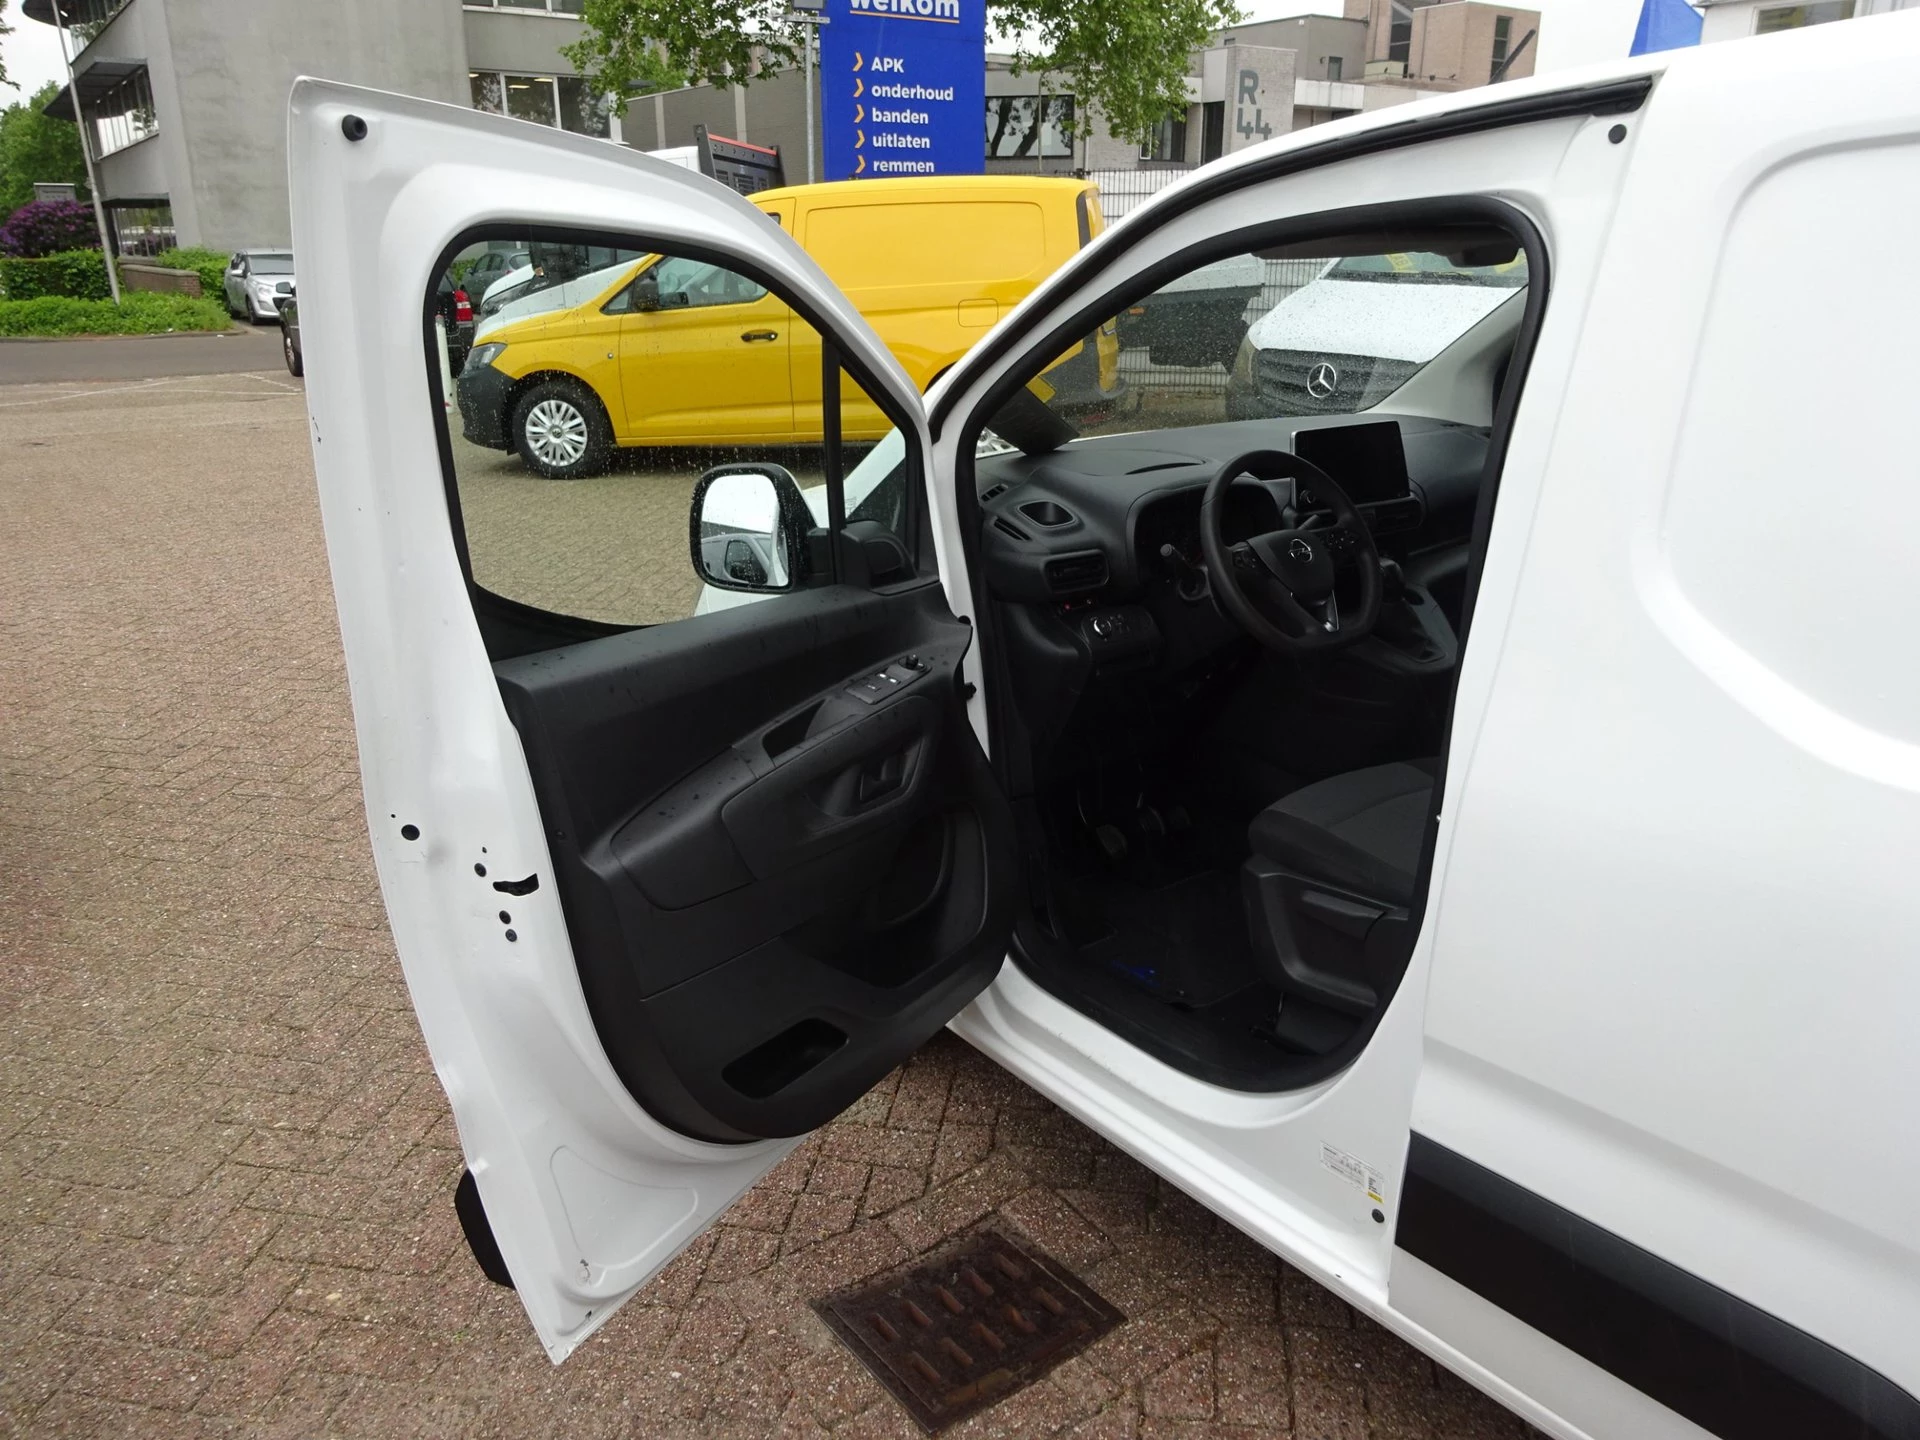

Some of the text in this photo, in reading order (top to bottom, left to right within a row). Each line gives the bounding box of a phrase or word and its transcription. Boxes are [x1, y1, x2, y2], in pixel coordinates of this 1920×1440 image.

[871, 57, 904, 73] APK
[871, 83, 954, 101] onderhoud
[1238, 69, 1259, 105] R
[872, 107, 929, 124] banden
[1236, 107, 1272, 140] 44
[872, 133, 931, 149] uitlaten
[873, 160, 935, 173] remmen
